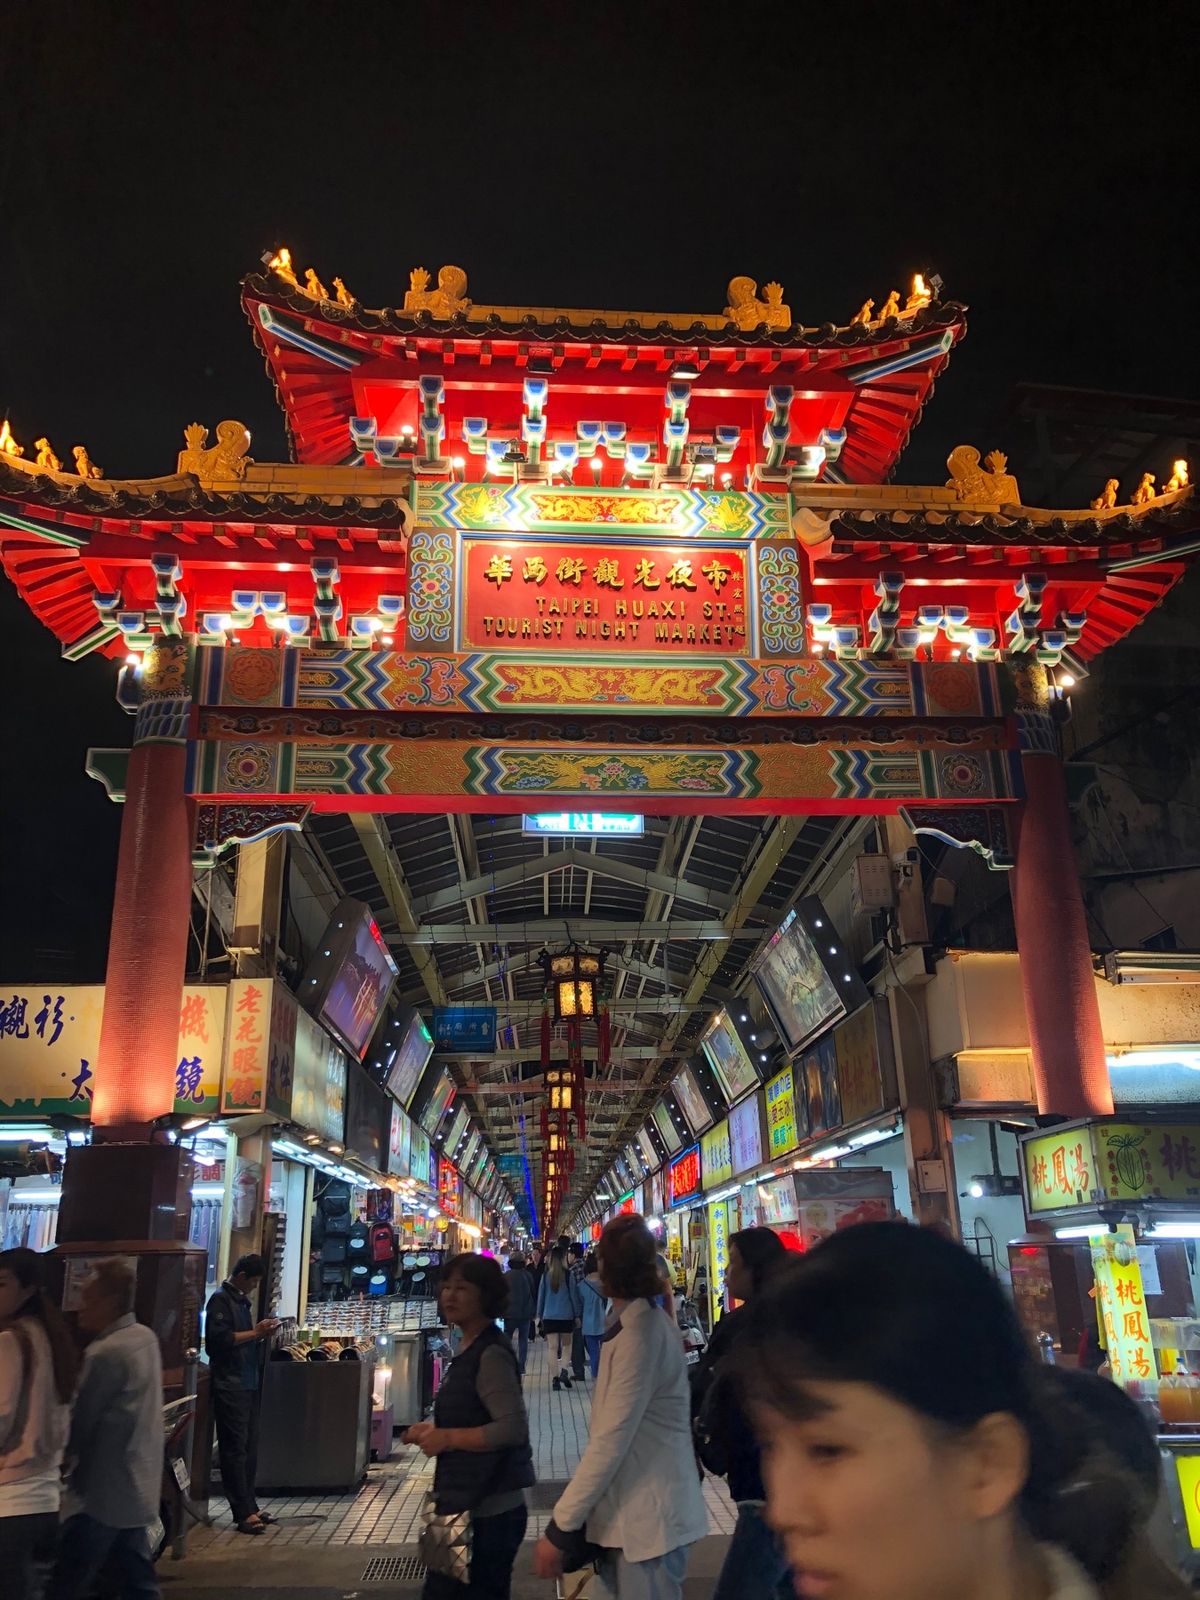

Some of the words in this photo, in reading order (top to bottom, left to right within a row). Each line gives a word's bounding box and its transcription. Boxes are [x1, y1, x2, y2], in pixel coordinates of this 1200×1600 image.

[484, 554, 732, 592] 華西街觀光夜市
[483, 616, 563, 639] TOURIST
[576, 620, 639, 640] NIGHT
[655, 622, 735, 645] MARKET
[536, 597, 599, 617] TAIPEI
[615, 599, 687, 620] HUAXI
[703, 601, 732, 621] ST.
[229, 984, 263, 1106] 老花眼鏡
[1031, 1143, 1089, 1195] 桃鳳湯
[1115, 1277, 1151, 1378] 桃鳳湯
